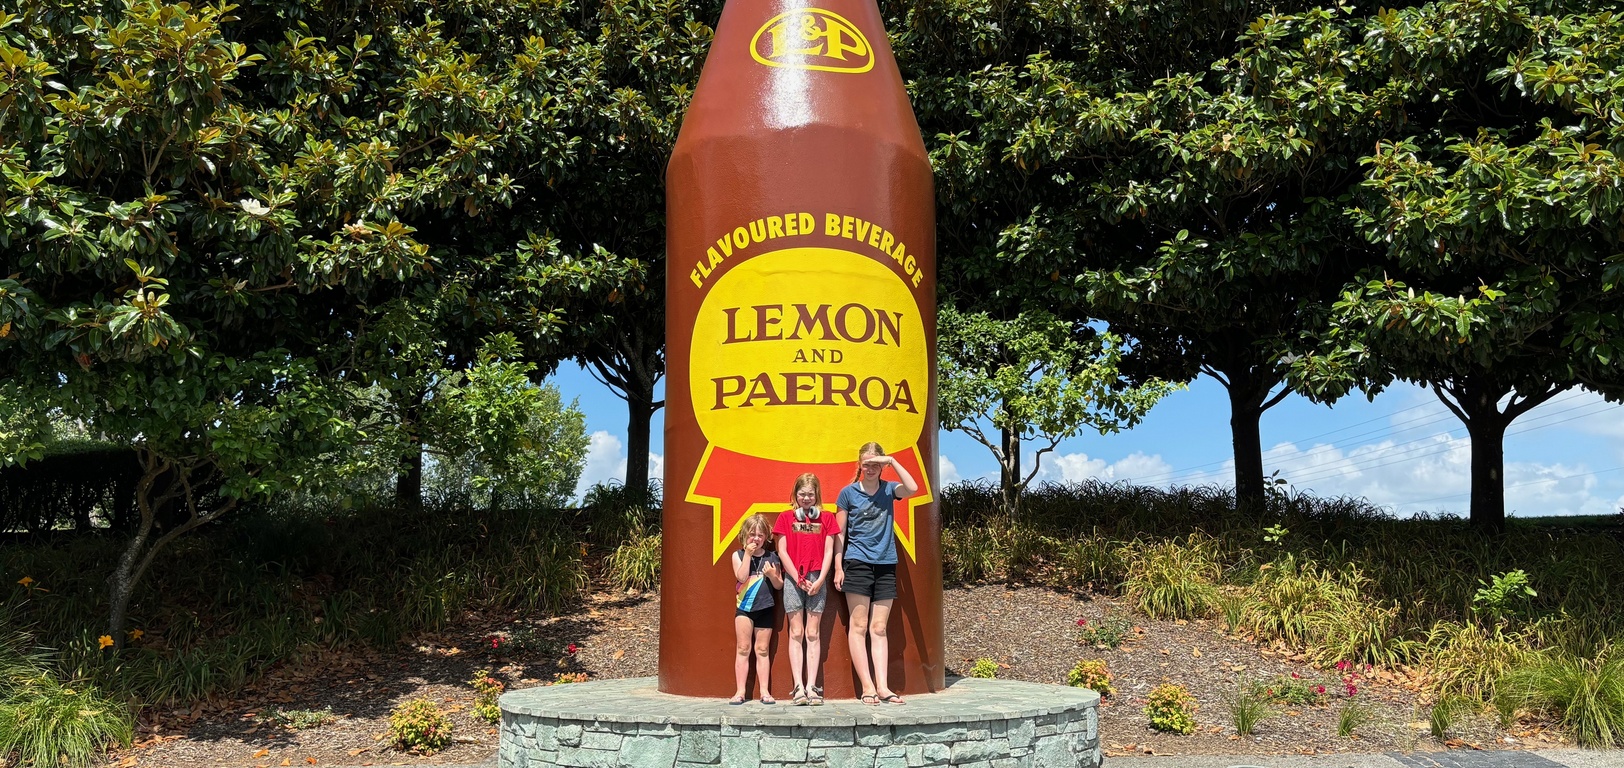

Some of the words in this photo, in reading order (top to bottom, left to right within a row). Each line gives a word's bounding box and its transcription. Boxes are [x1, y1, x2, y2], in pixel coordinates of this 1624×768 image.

[767, 14, 867, 61] L&P
[690, 212, 816, 289] FLAVOURED
[825, 213, 924, 288] BEVERAGE
[722, 303, 904, 348] LEMON
[792, 349, 843, 364] AND
[711, 372, 919, 414] PAEROA
